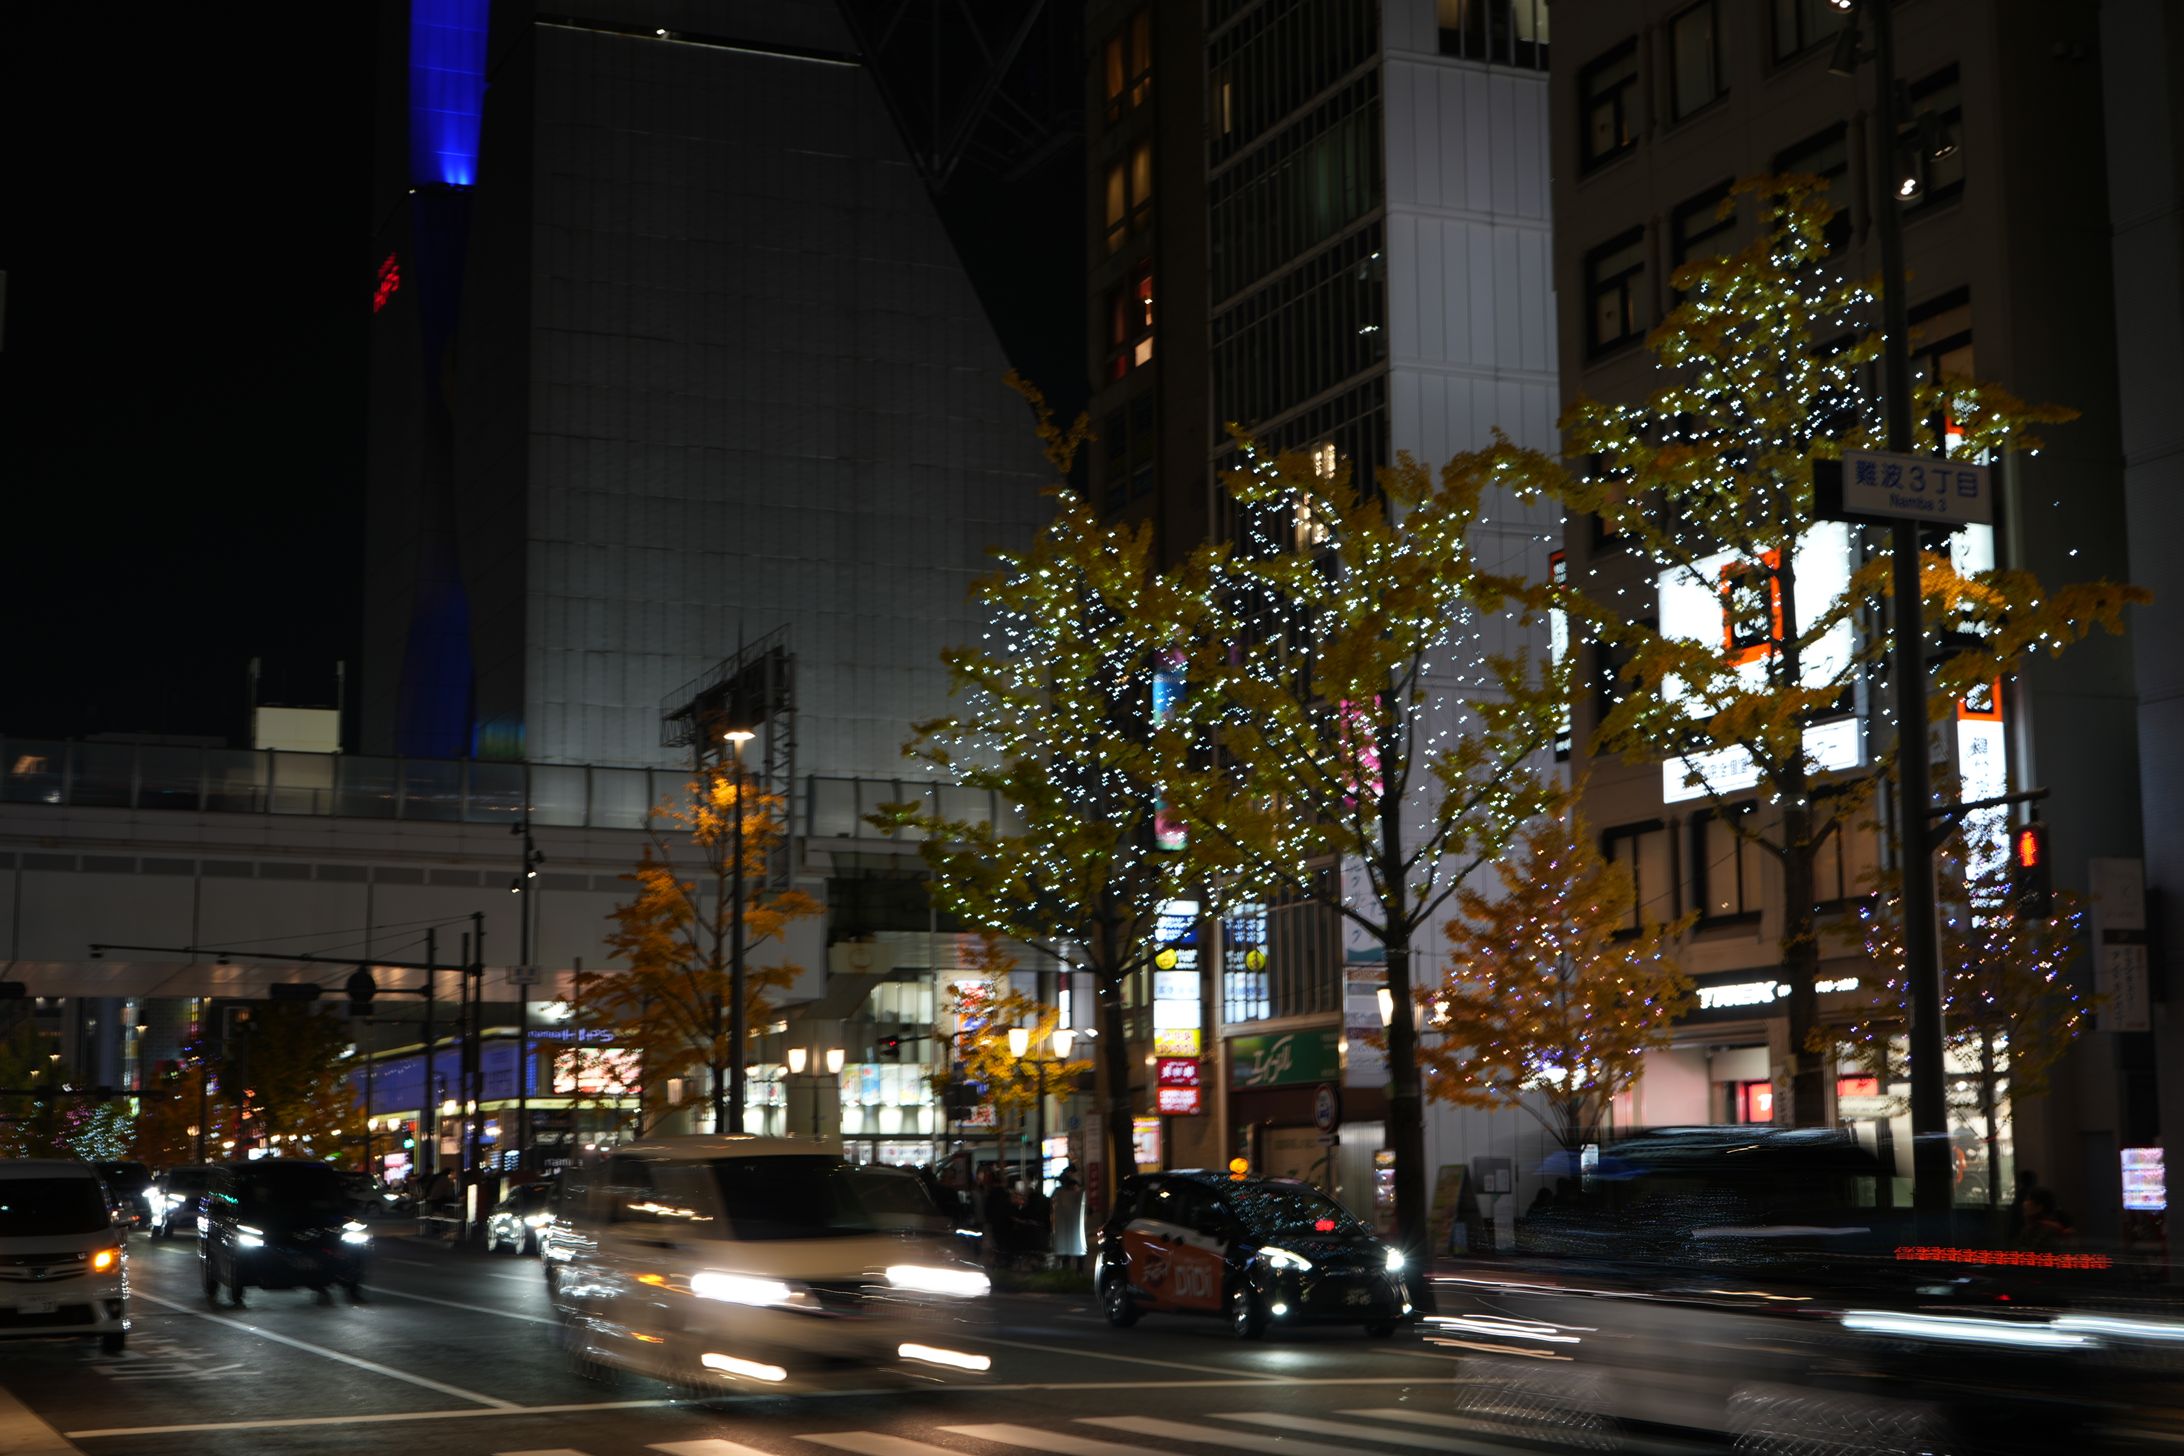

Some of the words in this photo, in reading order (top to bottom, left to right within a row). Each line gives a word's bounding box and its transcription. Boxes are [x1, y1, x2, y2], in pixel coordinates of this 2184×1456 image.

[1855, 460, 1978, 498] 難波3丁目
[1889, 493, 1935, 512] Namba
[1939, 499, 1947, 513] 3
